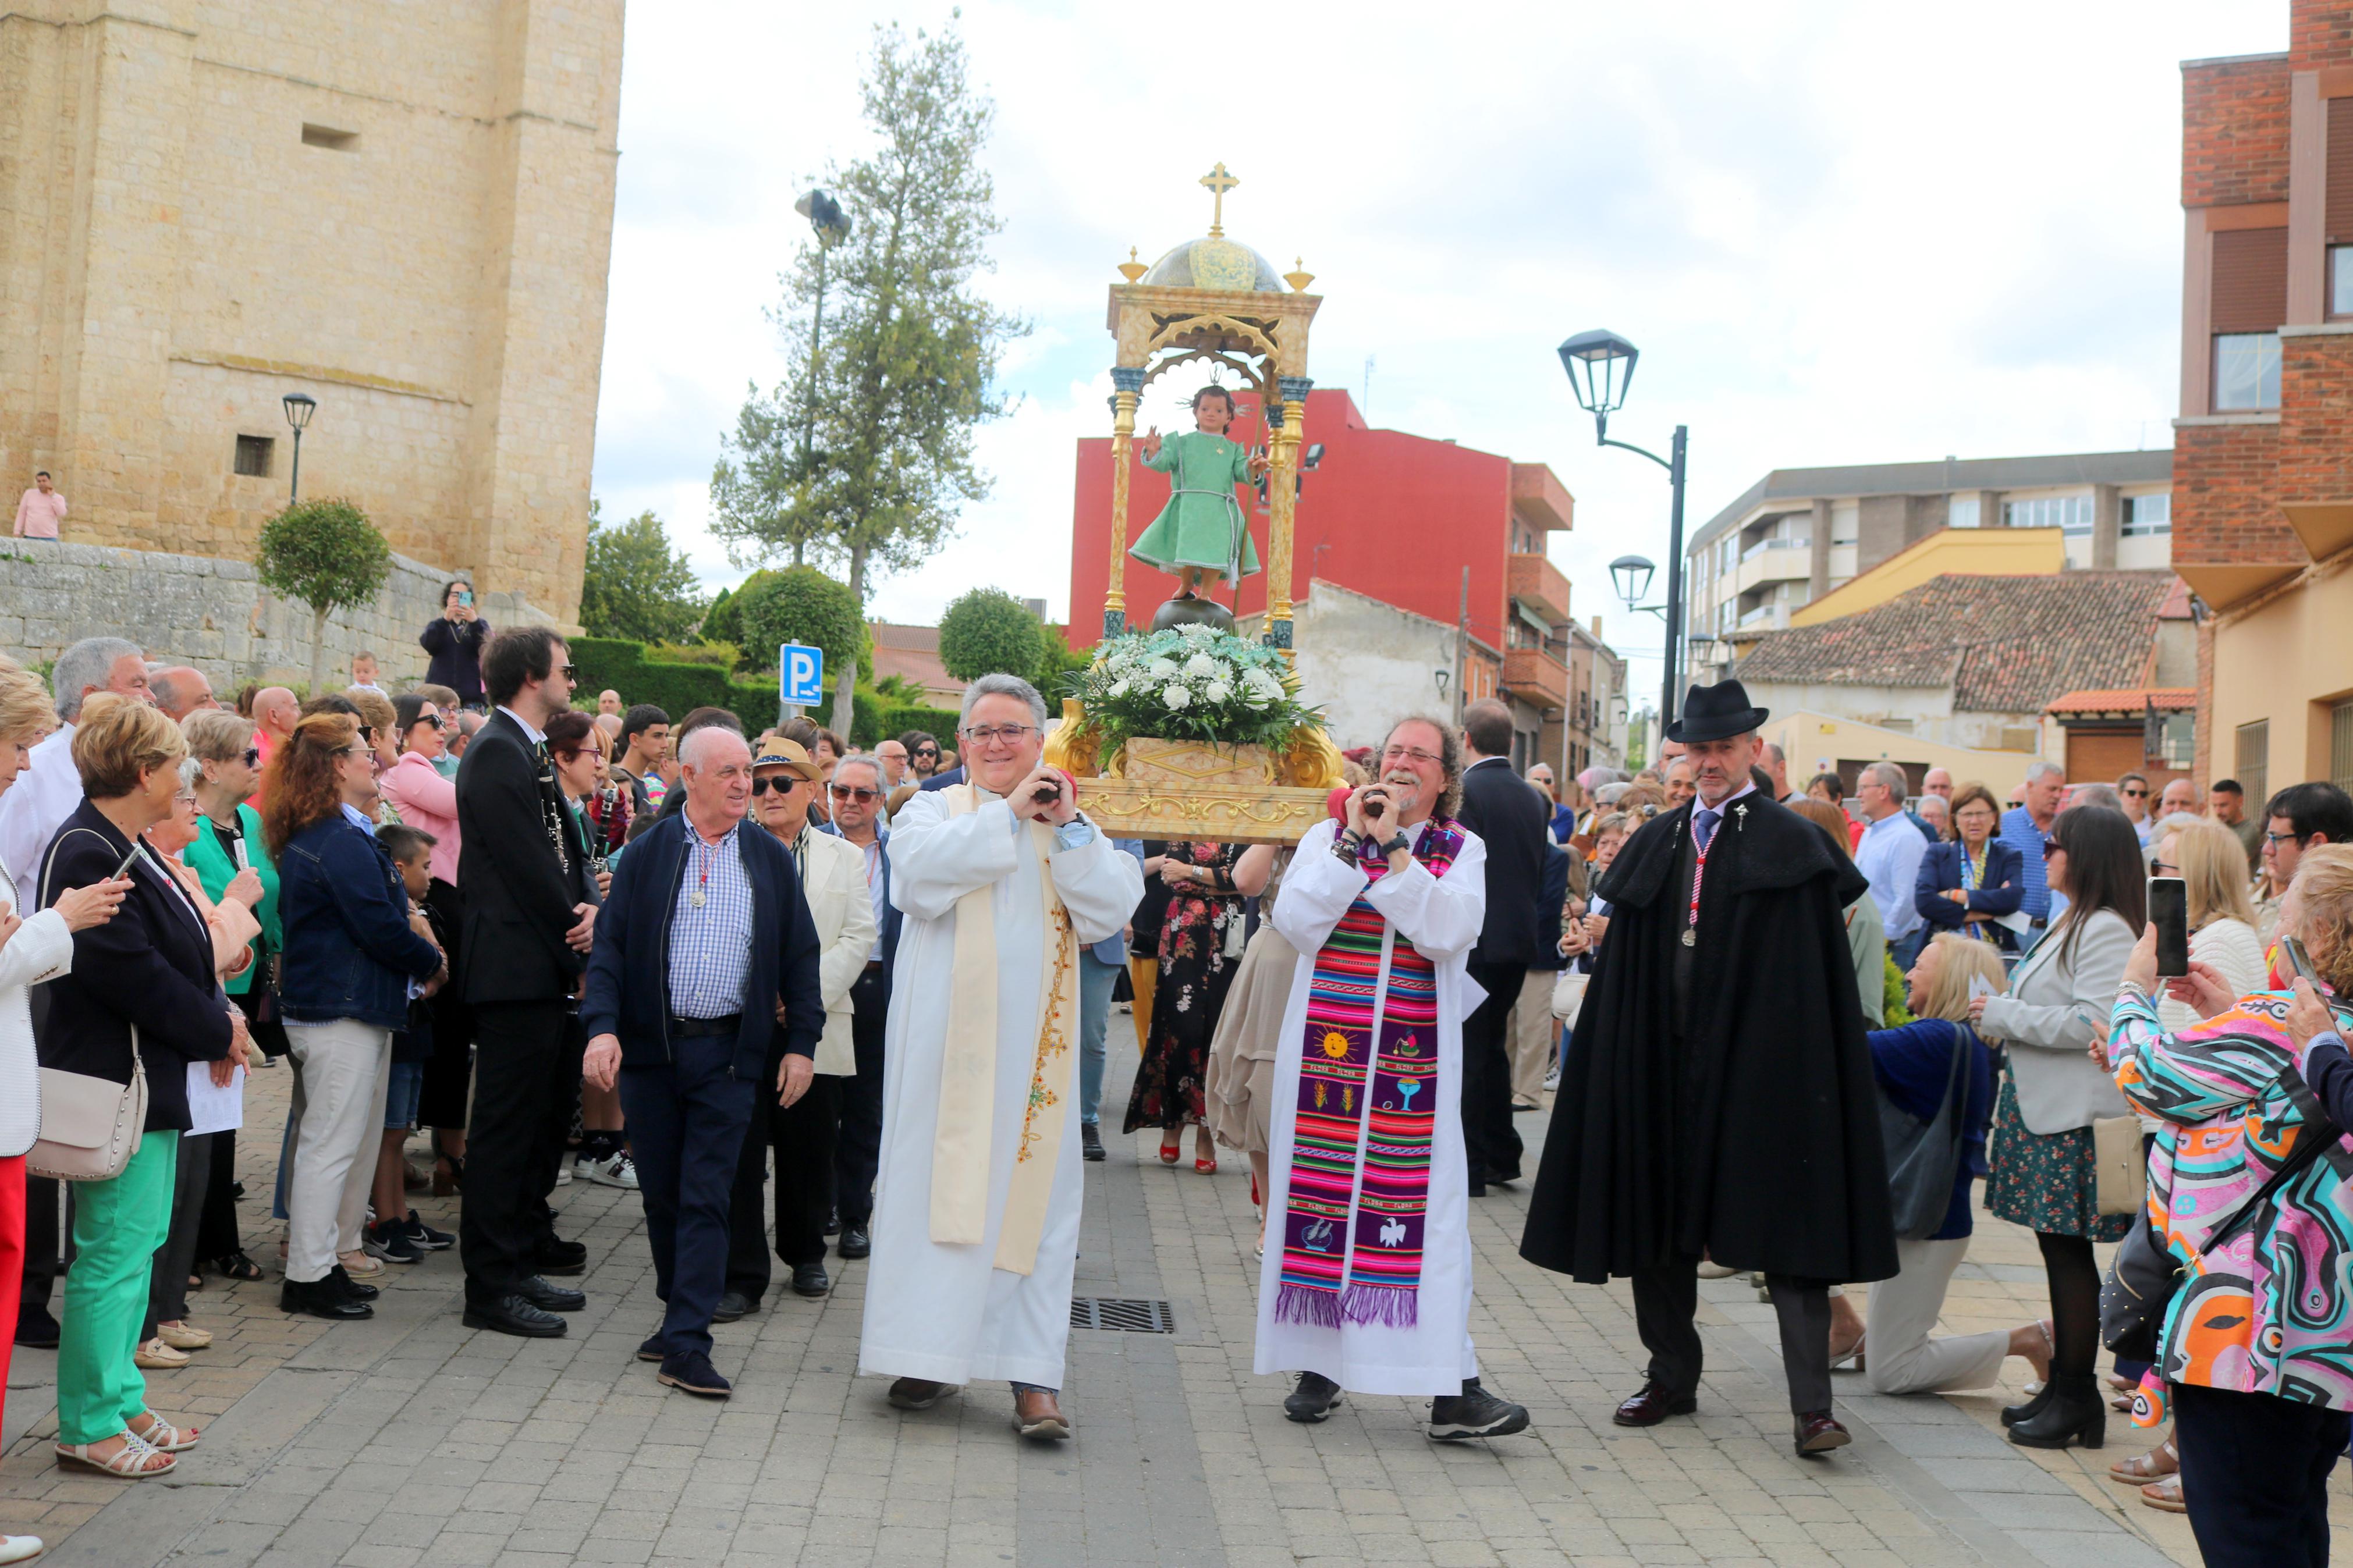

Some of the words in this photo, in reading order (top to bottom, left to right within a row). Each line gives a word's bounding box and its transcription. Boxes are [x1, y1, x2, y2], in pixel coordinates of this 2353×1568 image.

[790, 652, 814, 696] P
[1308, 1203, 1326, 1211] FLORA
[1364, 1199, 1383, 1207] FLORA
